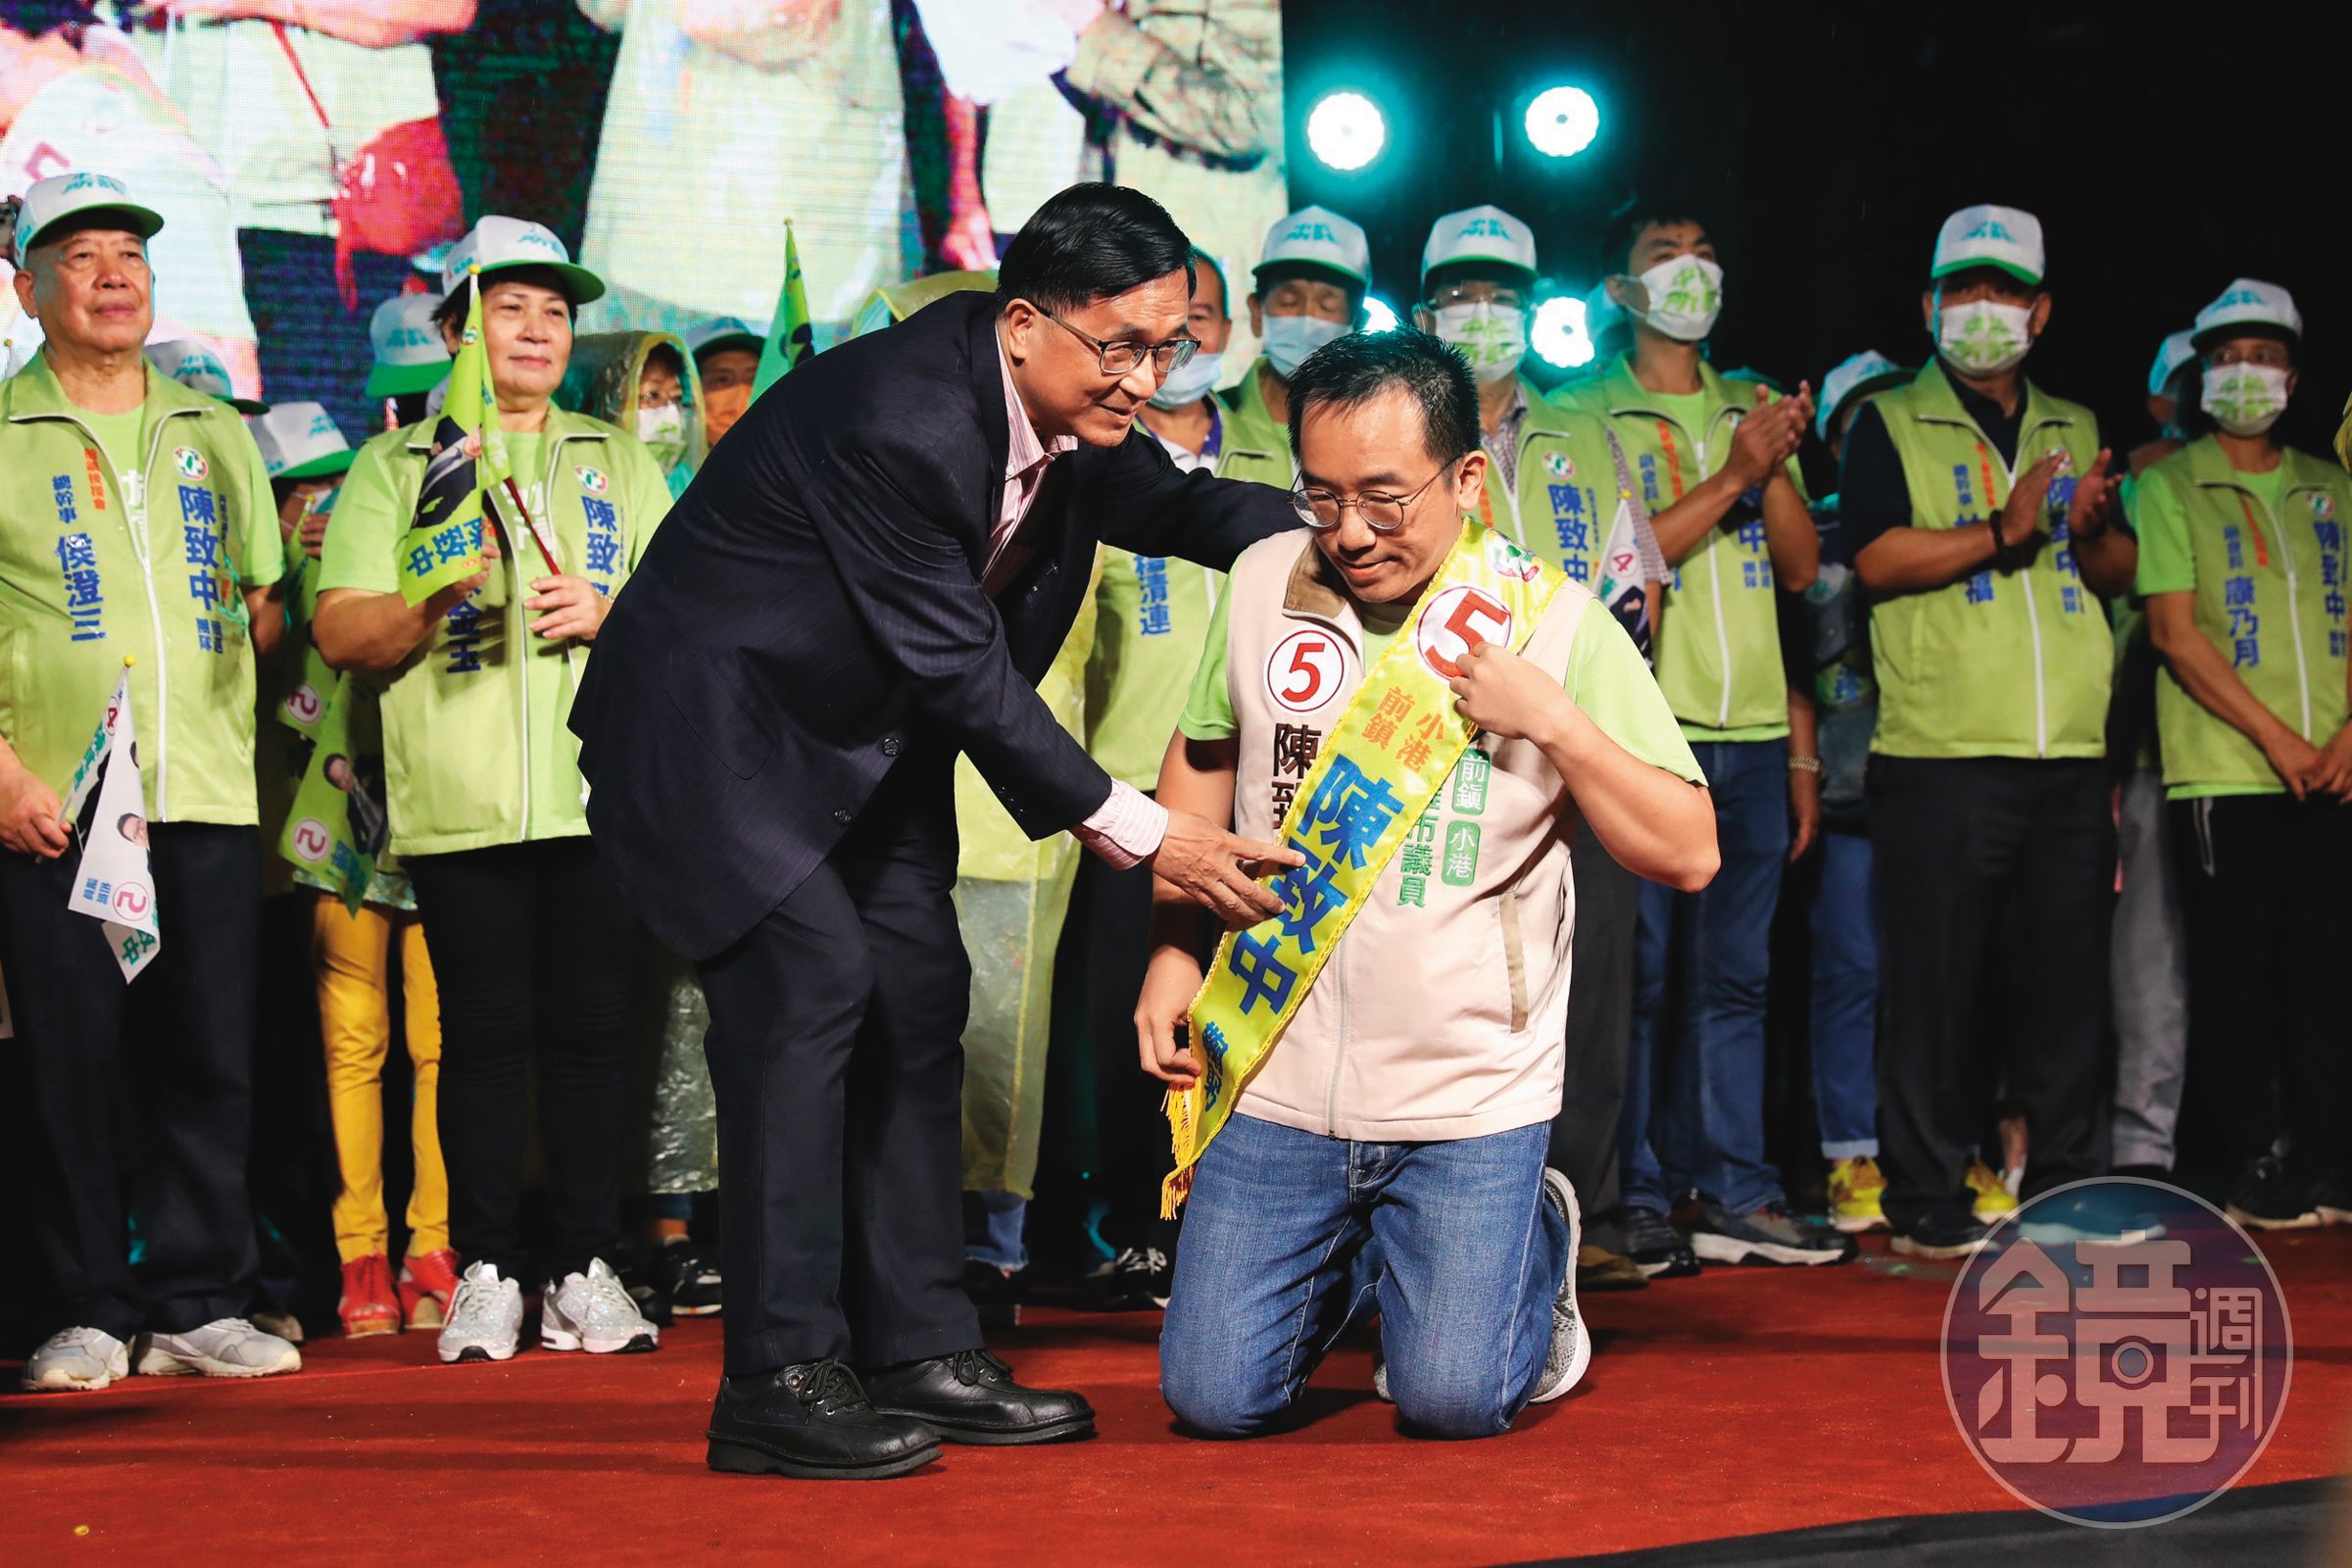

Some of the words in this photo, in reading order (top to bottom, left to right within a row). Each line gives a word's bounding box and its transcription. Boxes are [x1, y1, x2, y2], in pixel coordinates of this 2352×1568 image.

[177, 484, 220, 612] 陳致中
[407, 516, 483, 578] 陳致中
[580, 495, 619, 595] 陳致
[1547, 483, 1590, 583] 陳致中
[1424, 590, 1510, 678] 5
[1281, 642, 1326, 703] 5
[1361, 686, 1416, 751] 前鎮
[1395, 712, 1445, 773] 小港
[1454, 756, 1489, 809] 前鎮
[1226, 753, 1405, 1015] 陳致中
[1448, 828, 1477, 880] 小港
